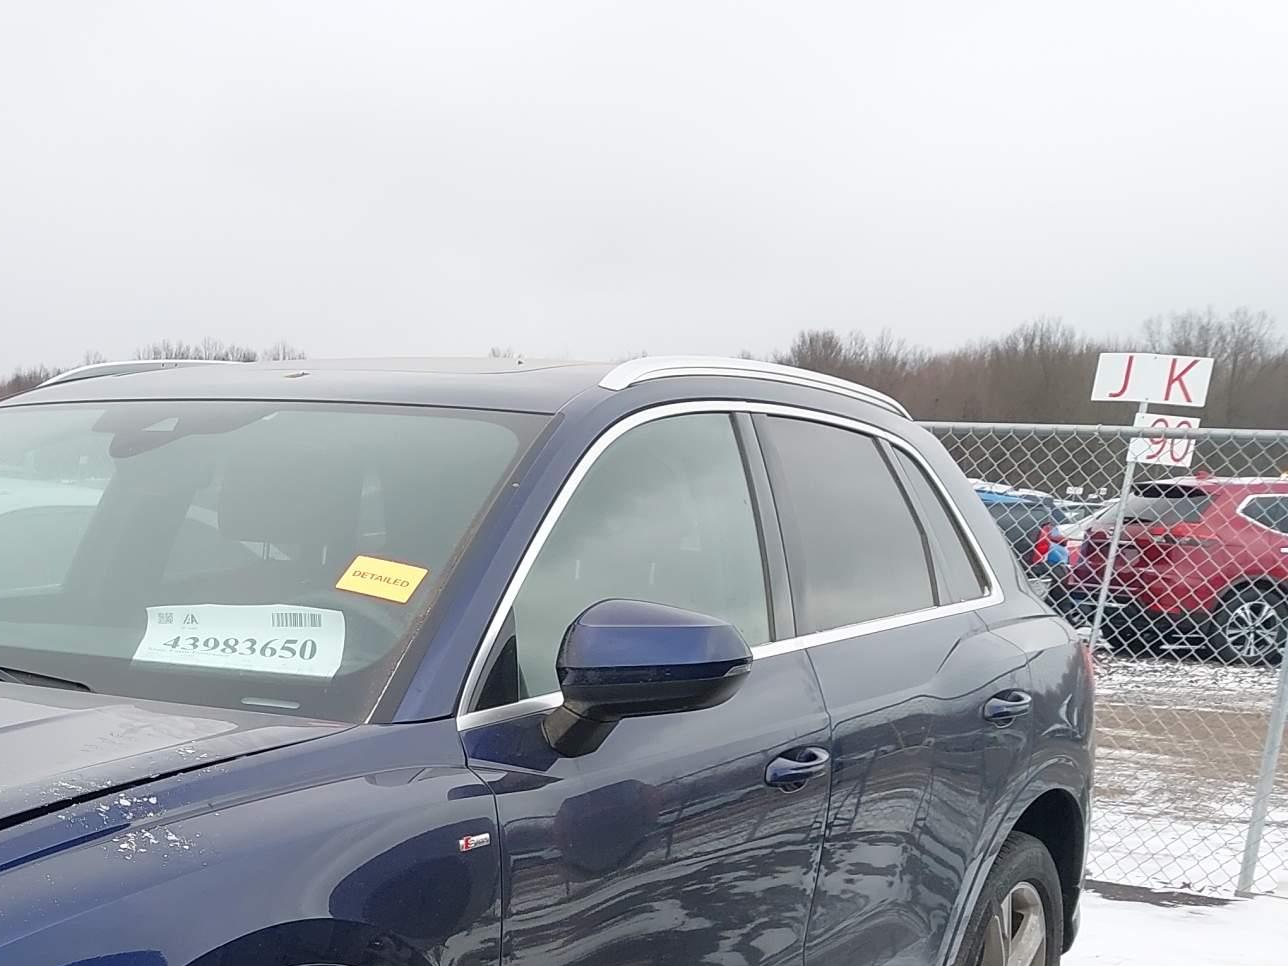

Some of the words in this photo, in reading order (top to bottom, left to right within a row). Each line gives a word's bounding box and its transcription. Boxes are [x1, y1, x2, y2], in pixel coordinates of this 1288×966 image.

[1108, 355, 1134, 398] J
[1163, 358, 1201, 403] K
[1145, 418, 1192, 462] 90
[352, 570, 410, 588] DETAILED
[162, 635, 318, 661] 43983650
